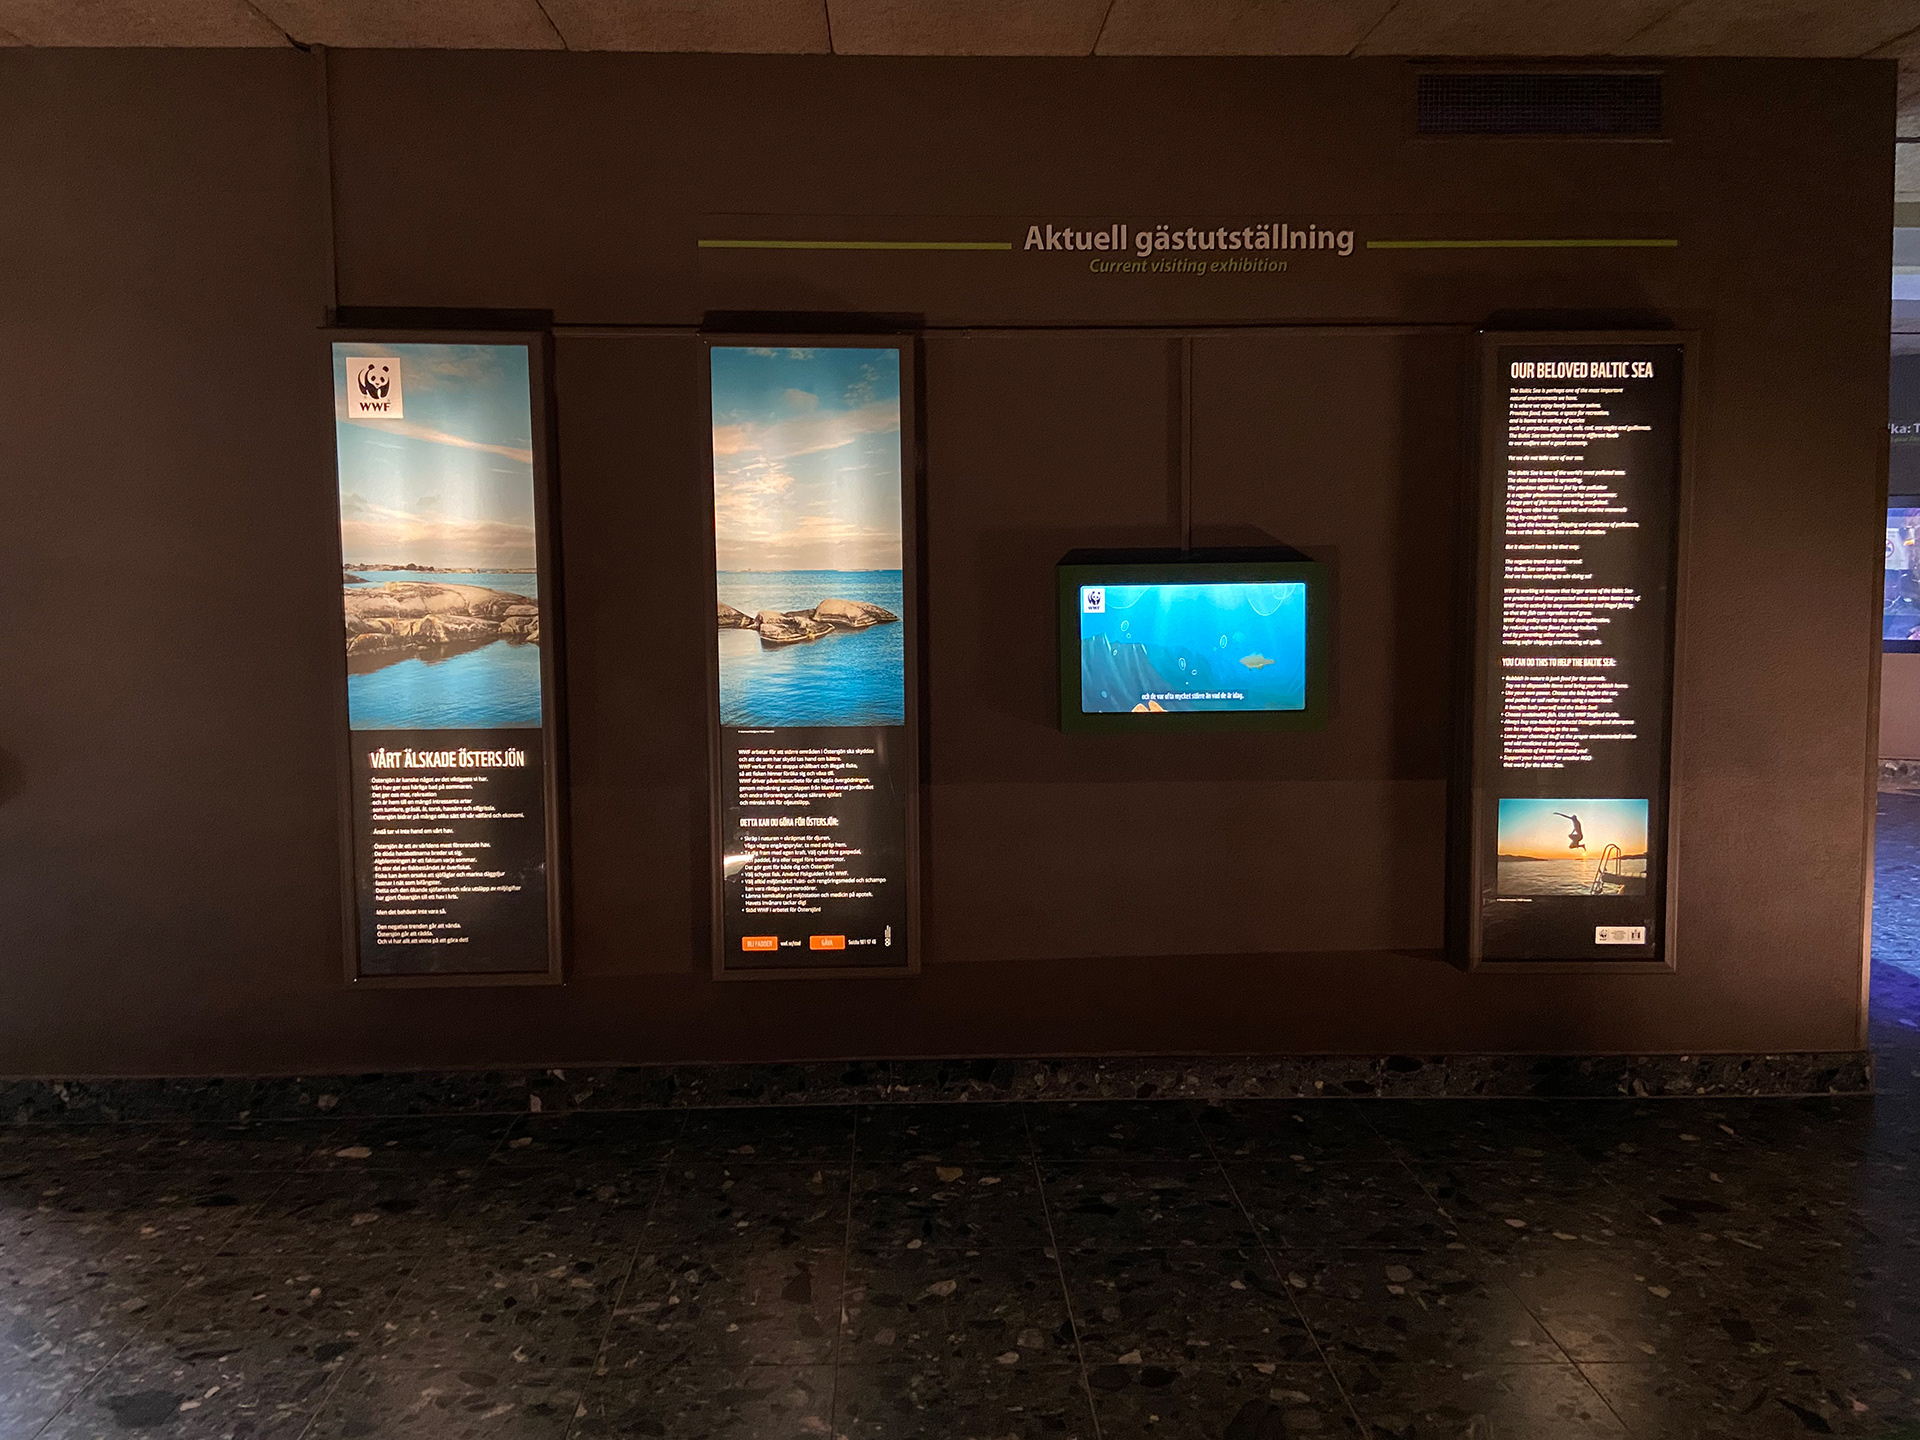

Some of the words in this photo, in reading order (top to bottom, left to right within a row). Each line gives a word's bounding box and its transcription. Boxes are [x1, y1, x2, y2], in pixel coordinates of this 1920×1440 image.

[1024, 224, 1128, 250] Aktuell
[1135, 223, 1354, 257] gästutställning
[1089, 258, 1148, 273] Current
[1151, 258, 1207, 276] visiting
[1210, 258, 1288, 272] exhibition
[1510, 362, 1535, 378] OUR
[1536, 362, 1589, 378] BELOVED
[1590, 362, 1630, 378] BALTIC
[1631, 362, 1654, 378] SEA
[360, 402, 391, 412] WWF
[1502, 658, 1514, 666] YOU
[1514, 658, 1526, 666] CAN
[1526, 658, 1535, 666] DO
[1536, 658, 1548, 666] THIS
[1549, 658, 1556, 666] TO
[1557, 658, 1571, 666] HELP
[1572, 658, 1583, 666] THE
[1584, 658, 1602, 666] BALTIC
[370, 747, 402, 768] VÅRT
[404, 748, 457, 768] ÄLSKADE
[458, 747, 525, 768] ÖSTERSJÖN
[771, 818, 778, 826] DU
[779, 817, 794, 826] GÖRA
[794, 817, 805, 826] FÖR
